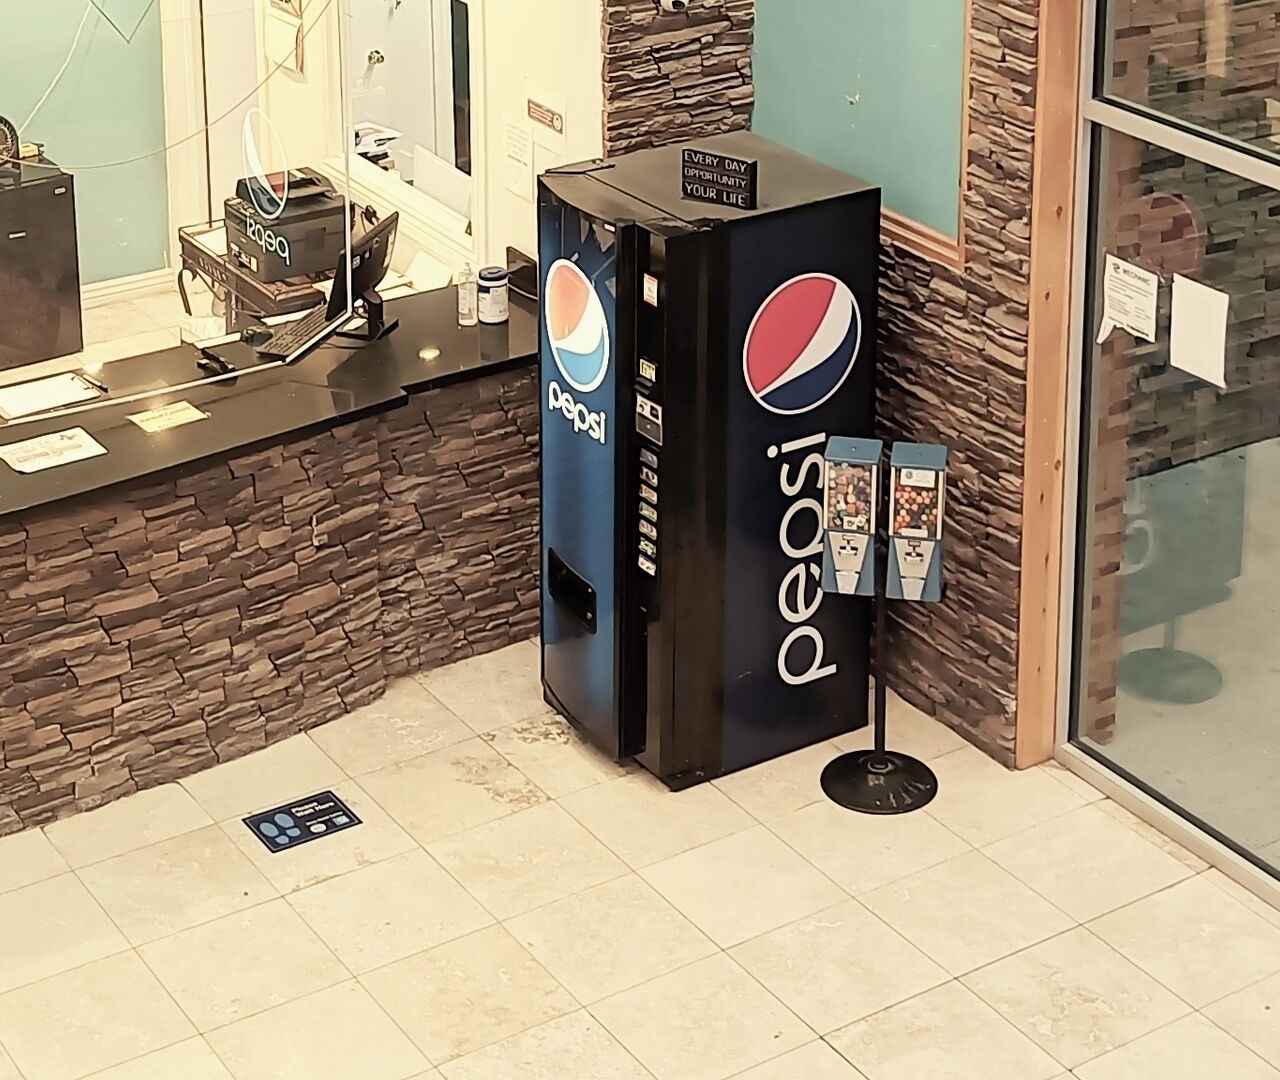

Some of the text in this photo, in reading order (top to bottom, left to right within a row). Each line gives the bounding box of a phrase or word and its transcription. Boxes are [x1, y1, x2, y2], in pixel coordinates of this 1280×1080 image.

[684, 150, 747, 173] EVERY DAY
[684, 167, 747, 188] OPPORTUNITY
[684, 182, 746, 207] YOUR LIFE
[548, 381, 606, 444] pepsi
[767, 432, 837, 685] pepsi
